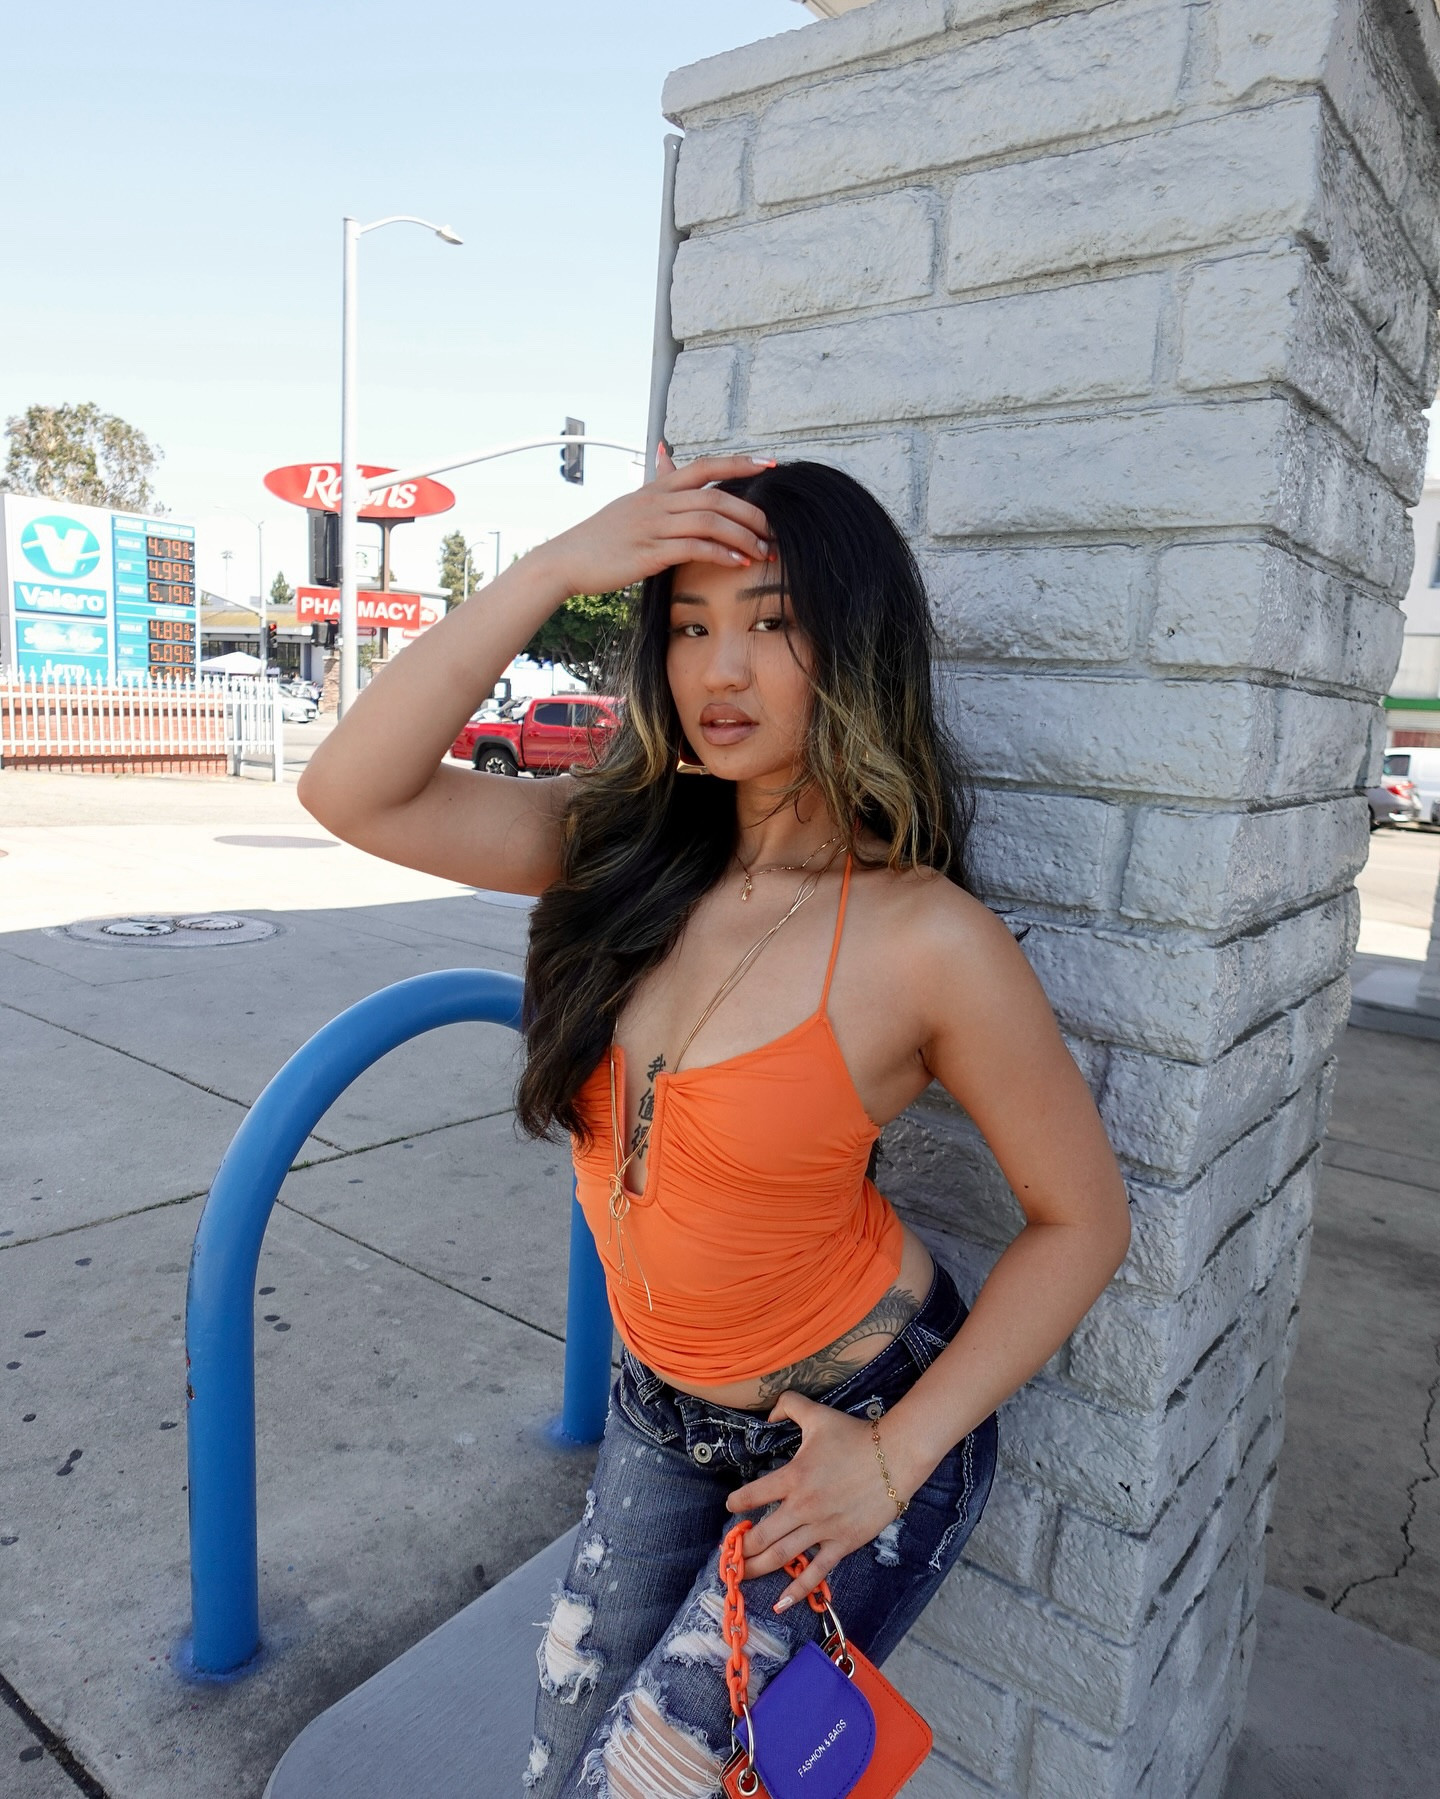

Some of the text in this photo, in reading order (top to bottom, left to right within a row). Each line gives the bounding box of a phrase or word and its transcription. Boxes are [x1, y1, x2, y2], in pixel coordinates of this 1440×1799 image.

[19, 585, 104, 612] Valero
[301, 597, 416, 620] PHAMACY
[797, 1744, 826, 1778] FASHION
[828, 1718, 847, 1742] BAGS
